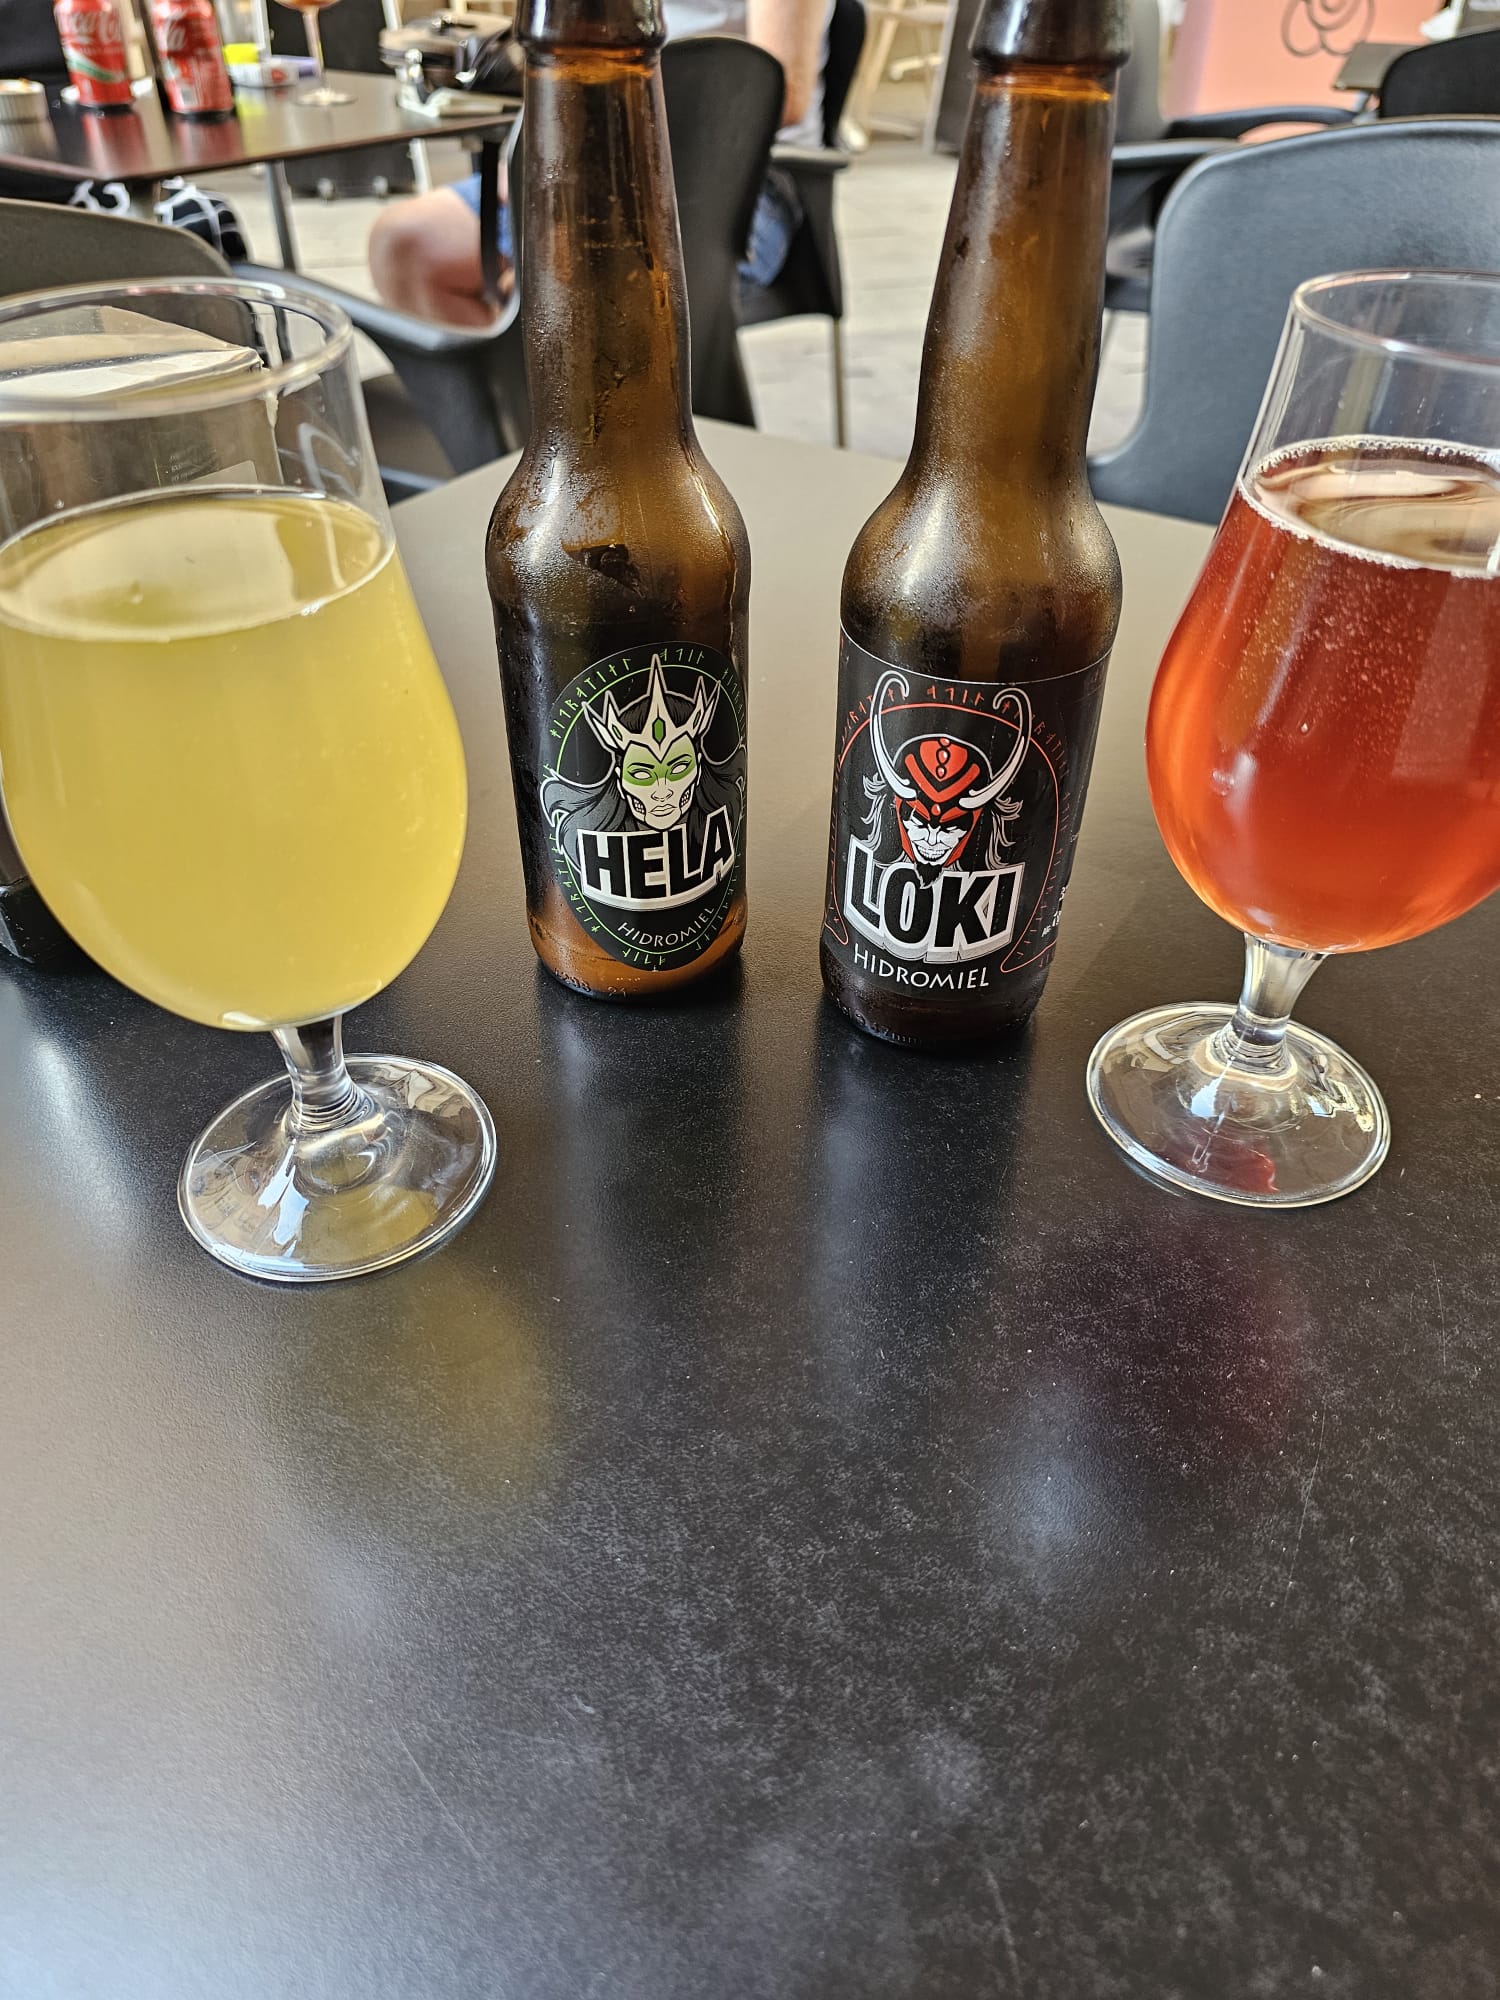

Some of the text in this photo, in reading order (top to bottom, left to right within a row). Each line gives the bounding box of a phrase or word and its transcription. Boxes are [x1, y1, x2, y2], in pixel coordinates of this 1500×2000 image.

[577, 806, 735, 907] HELA
[617, 906, 715, 947] HIDROMIEL
[845, 836, 1024, 960] LOKI
[854, 943, 990, 990] HIDROMIEL
